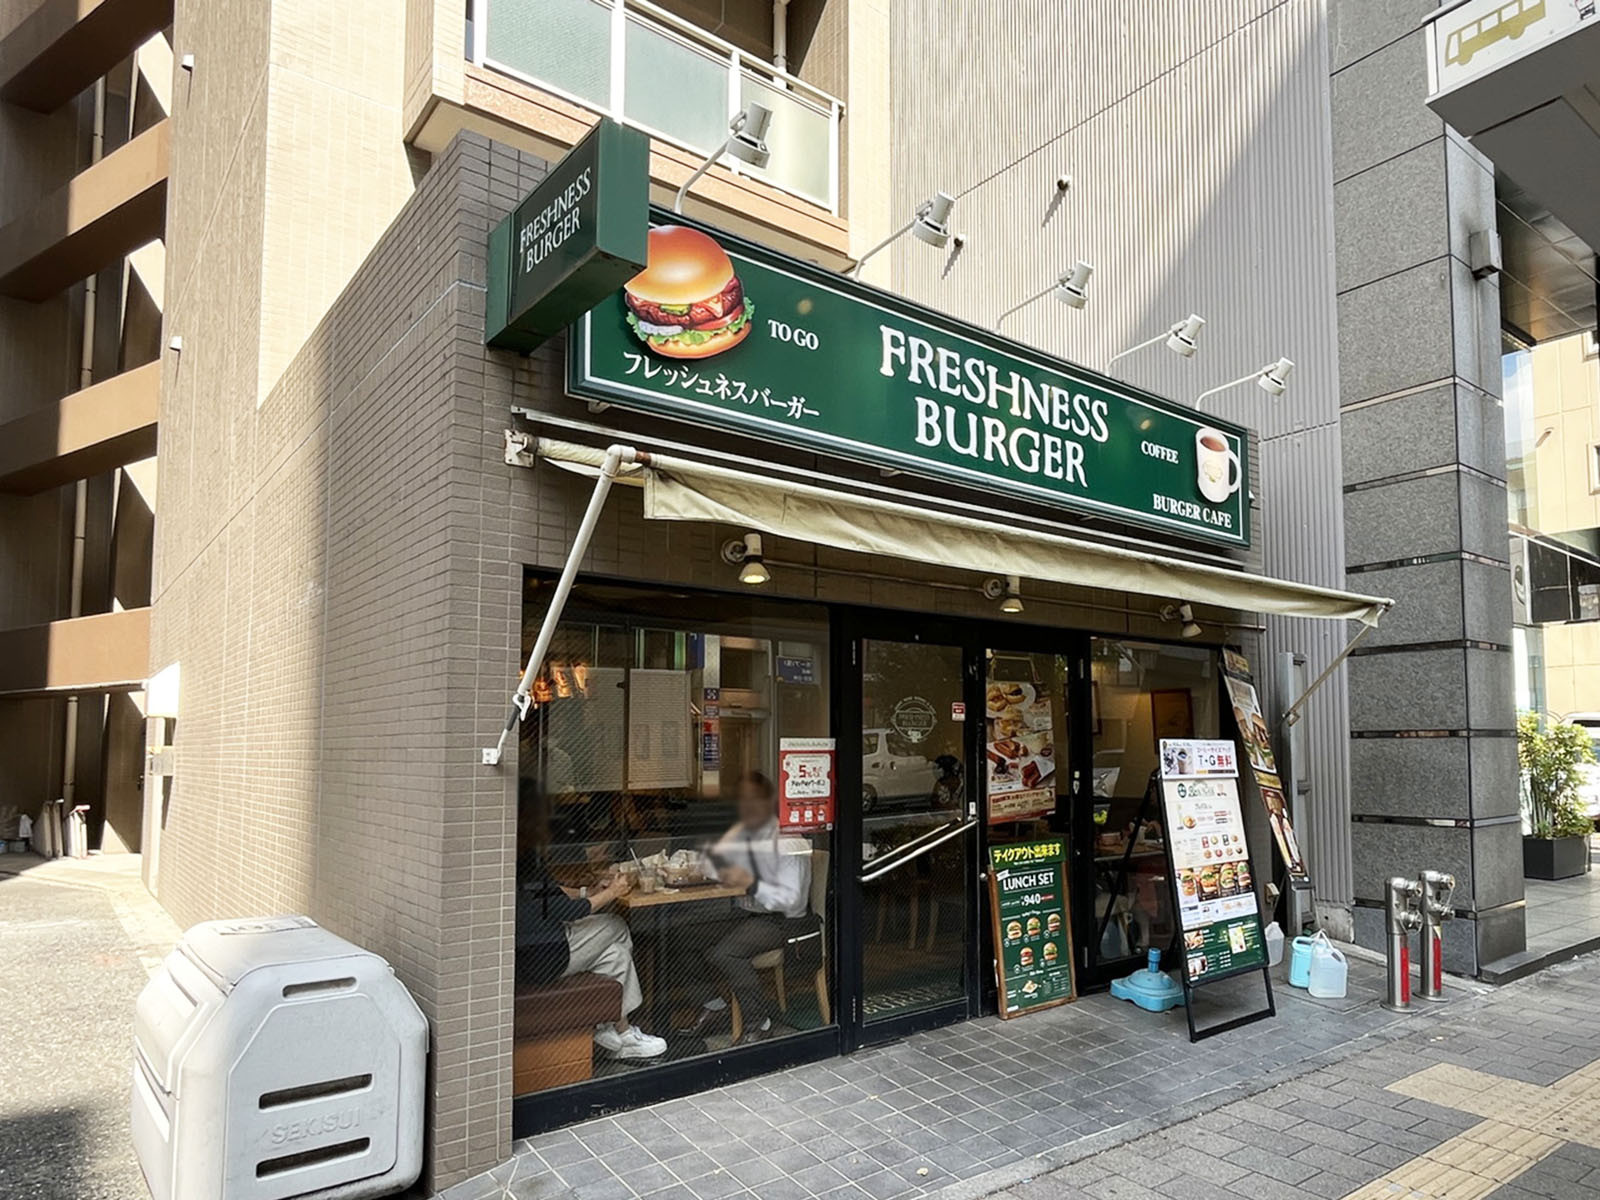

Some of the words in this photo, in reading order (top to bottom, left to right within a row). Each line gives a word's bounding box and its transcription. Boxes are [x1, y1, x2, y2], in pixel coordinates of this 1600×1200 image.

[520, 167, 592, 253] FRESHNESS
[526, 206, 581, 273] BURGER
[768, 319, 791, 341] TO
[794, 328, 819, 350] GO
[623, 351, 820, 420] フレッシュネスバーガー
[879, 325, 1109, 443] FRESHNESS
[915, 396, 1088, 488] BURGER
[1141, 440, 1179, 464] COFFEE
[1152, 494, 1201, 521] BURGER
[1203, 507, 1232, 528] CAFE
[993, 843, 1061, 863] テイクアウト出来ます
[1003, 874, 1036, 891] LUNCH
[1038, 872, 1055, 886] SET
[271, 1107, 362, 1145] SEKISUI
